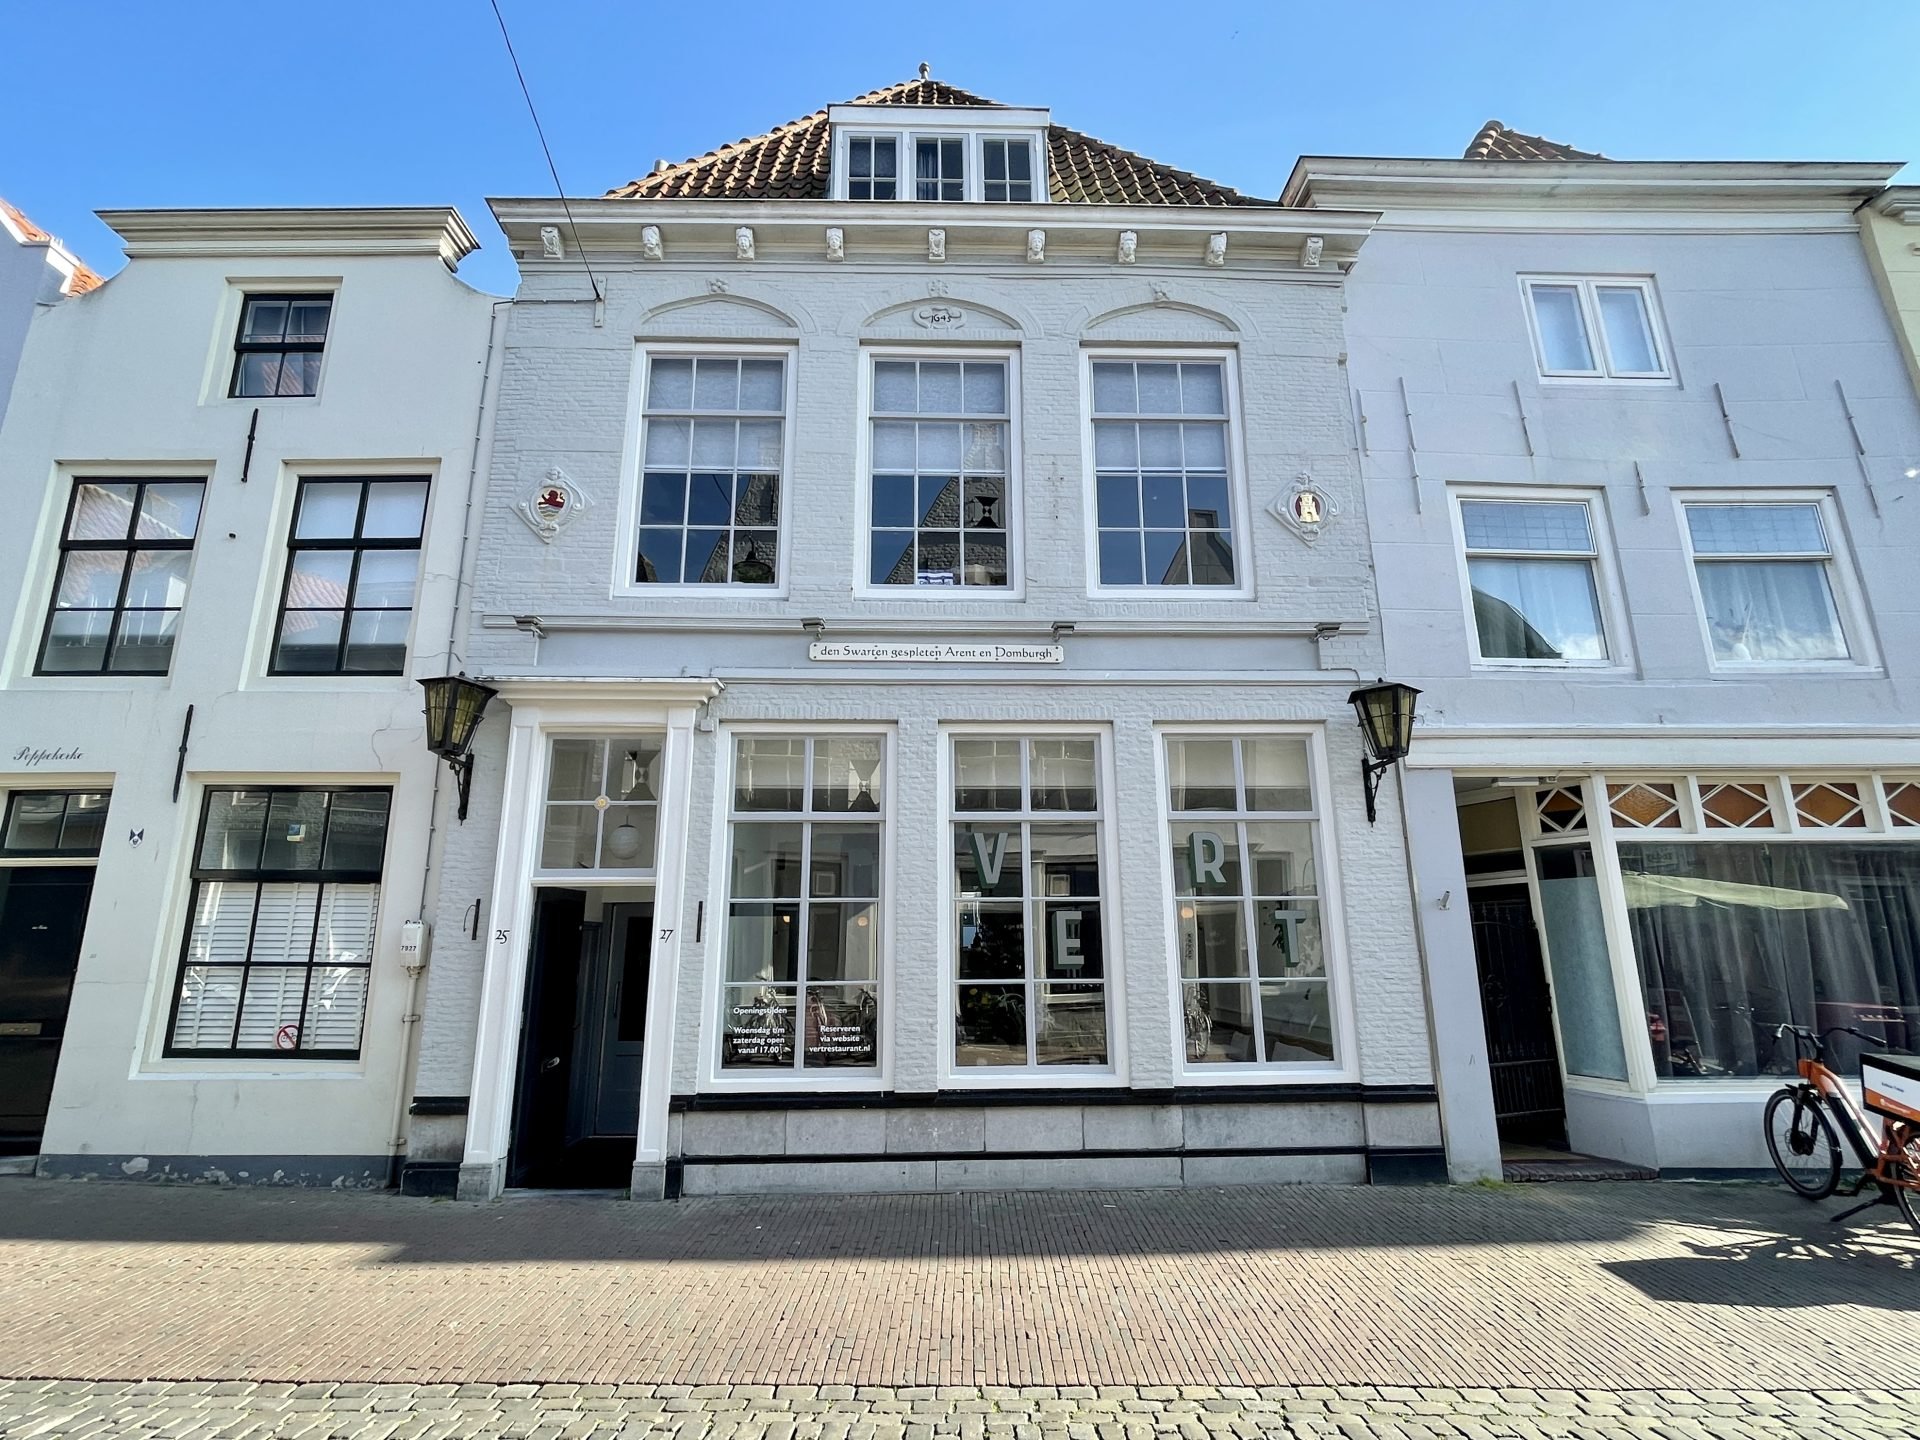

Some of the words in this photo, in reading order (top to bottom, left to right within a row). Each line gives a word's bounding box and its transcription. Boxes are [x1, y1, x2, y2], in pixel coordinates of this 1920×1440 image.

[820, 646, 840, 656] den
[843, 645, 888, 657] Swarten
[891, 647, 942, 658] gespleten
[945, 647, 976, 657] Arent
[995, 647, 1052, 660] Domburgh
[495, 929, 510, 944] 25
[659, 929, 674, 943] 27
[733, 1006, 787, 1016] Openingstijden
[733, 1026, 770, 1035] Woensdag
[733, 1037, 765, 1045] zaterdag
[766, 1037, 785, 1045] open
[738, 1046, 758, 1054] vanaf
[809, 1044, 871, 1053] vertrestaurant.nl
